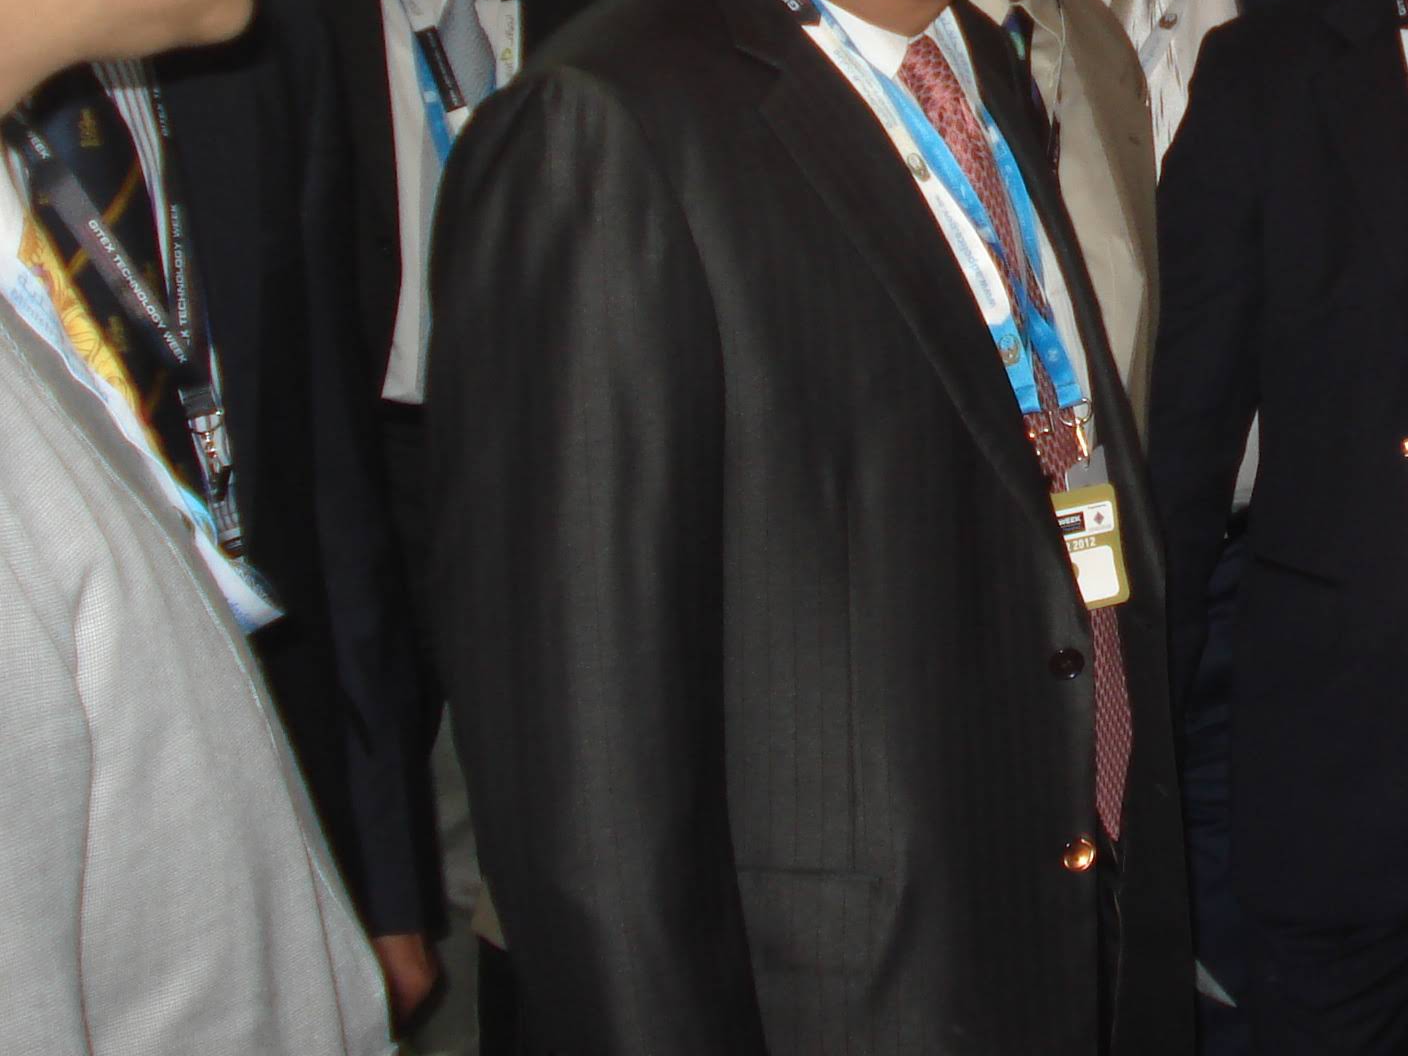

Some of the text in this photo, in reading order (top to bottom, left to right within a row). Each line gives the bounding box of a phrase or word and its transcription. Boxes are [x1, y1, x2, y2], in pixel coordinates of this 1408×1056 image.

[87, 218, 188, 365] GITEX TECHNOLOGY WEEK
[173, 243, 189, 327] TECHNOLOGY
